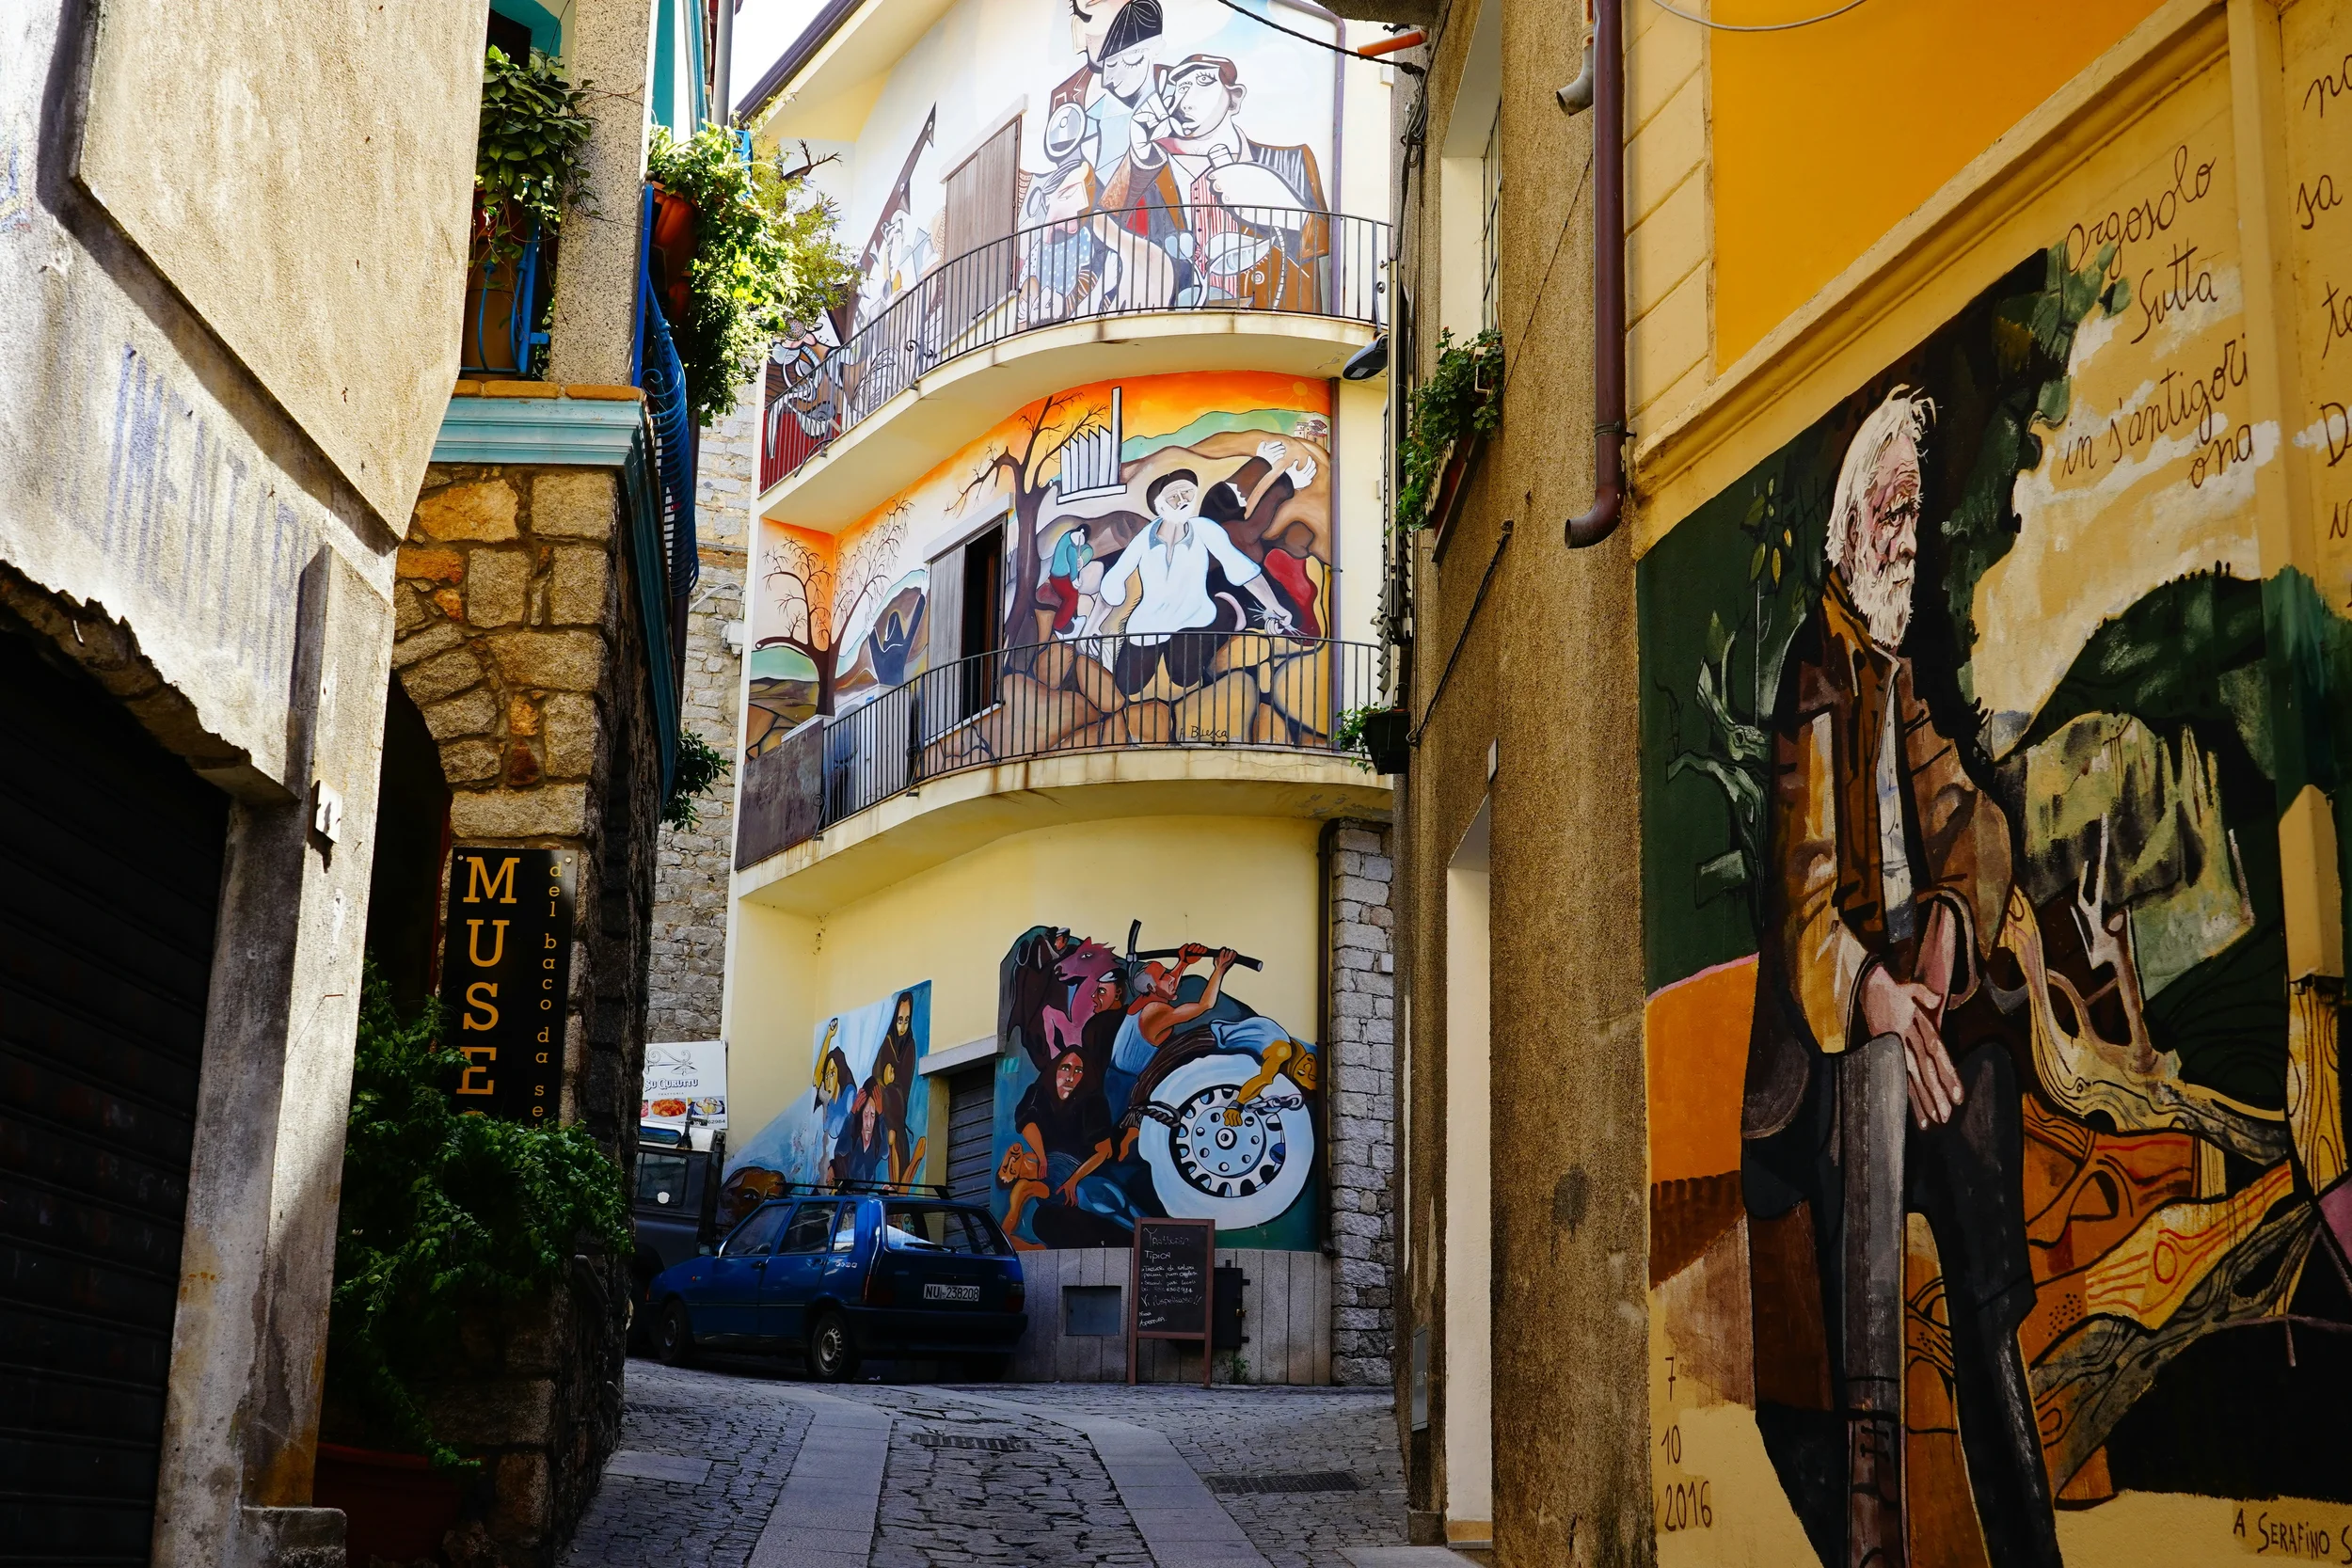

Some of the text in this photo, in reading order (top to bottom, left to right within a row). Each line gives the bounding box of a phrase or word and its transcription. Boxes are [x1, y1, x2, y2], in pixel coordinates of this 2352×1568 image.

[2064, 144, 2217, 281] Orgosolo
[2061, 421, 2098, 480] in
[455, 856, 520, 1118] MUSE
[532, 862, 563, 1131] del baco da se
[925, 1285, 979, 1300] NU 238208
[1664, 1356, 1676, 1402] 7
[1661, 1424, 1682, 1465] 10
[1664, 1480, 1712, 1532] 2016
[2233, 1508, 2246, 1538] A
